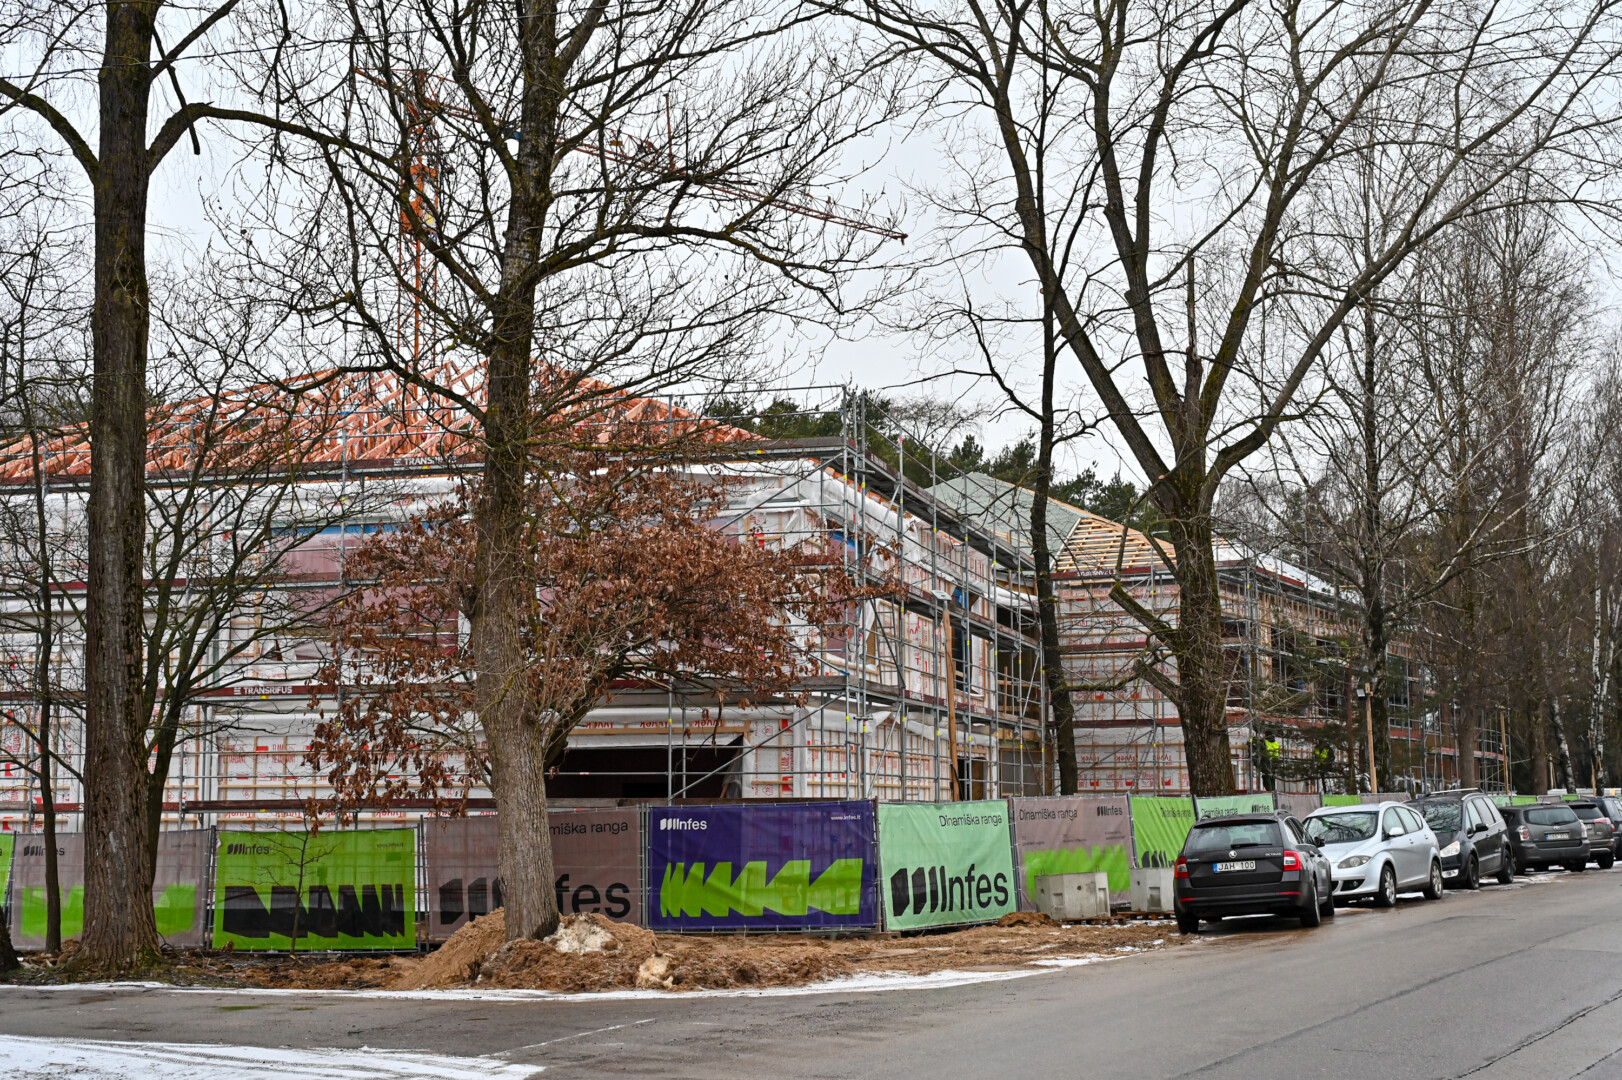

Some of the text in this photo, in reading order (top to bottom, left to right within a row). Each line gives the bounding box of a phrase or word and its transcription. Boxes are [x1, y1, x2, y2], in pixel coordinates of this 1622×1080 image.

[243, 686, 293, 695] TRANSRIFUS
[939, 813, 1003, 827] Dinamiška ranga
[1019, 807, 1078, 821] Dinamiška ranga
[590, 820, 629, 835] ranga
[676, 818, 708, 831] Infes
[241, 843, 270, 856] Infes
[1218, 861, 1256, 871] JAH 100
[939, 863, 1009, 914] Infes
